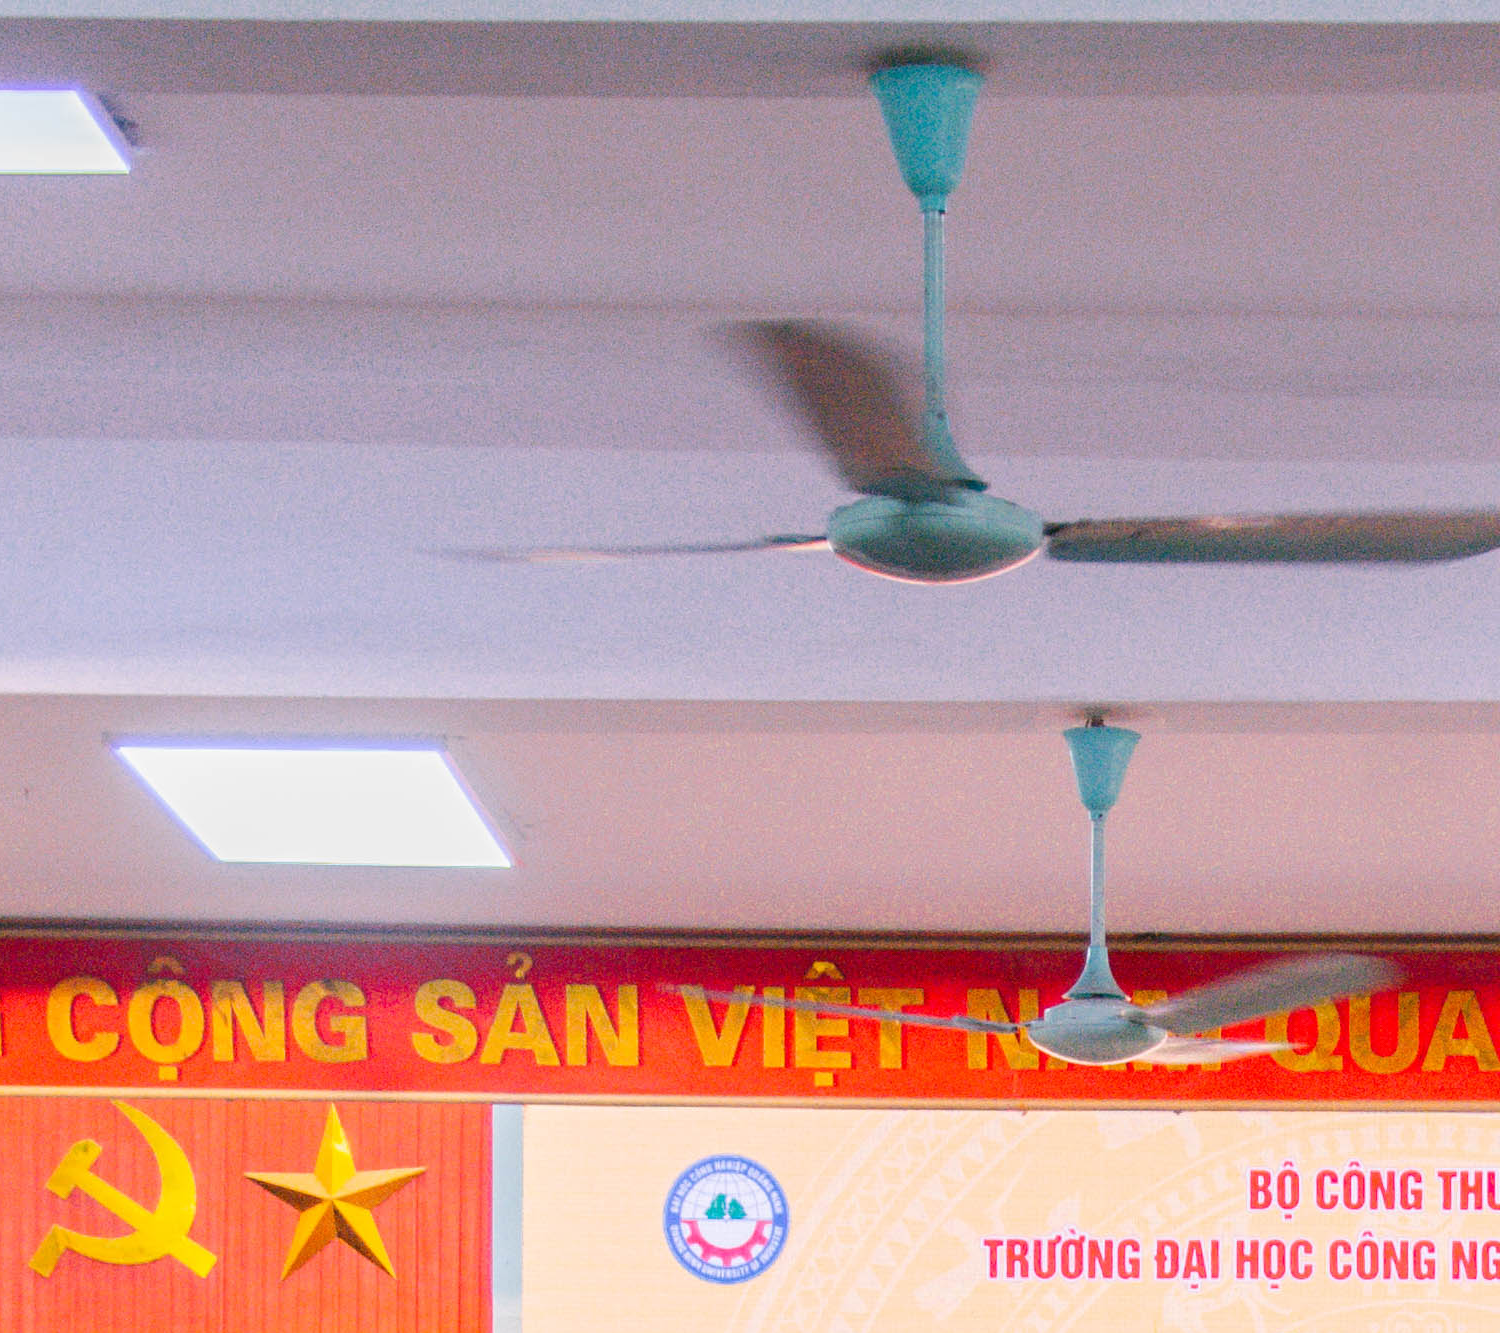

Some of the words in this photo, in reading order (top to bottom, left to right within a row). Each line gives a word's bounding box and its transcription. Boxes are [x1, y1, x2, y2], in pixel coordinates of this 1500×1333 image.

[46, 963, 370, 1081] CỘNG
[412, 951, 640, 1067] SẢN
[685, 962, 928, 1087] VIỆT
[1250, 1161, 1299, 1219] BỘ
[1316, 1162, 1422, 1210] CÔNG
[984, 1230, 1140, 1279] TRƯỜNG
[1155, 1240, 1219, 1288] ĐẠI
[1237, 1240, 1312, 1289] HỌC
[1330, 1232, 1435, 1280] CÔNG
